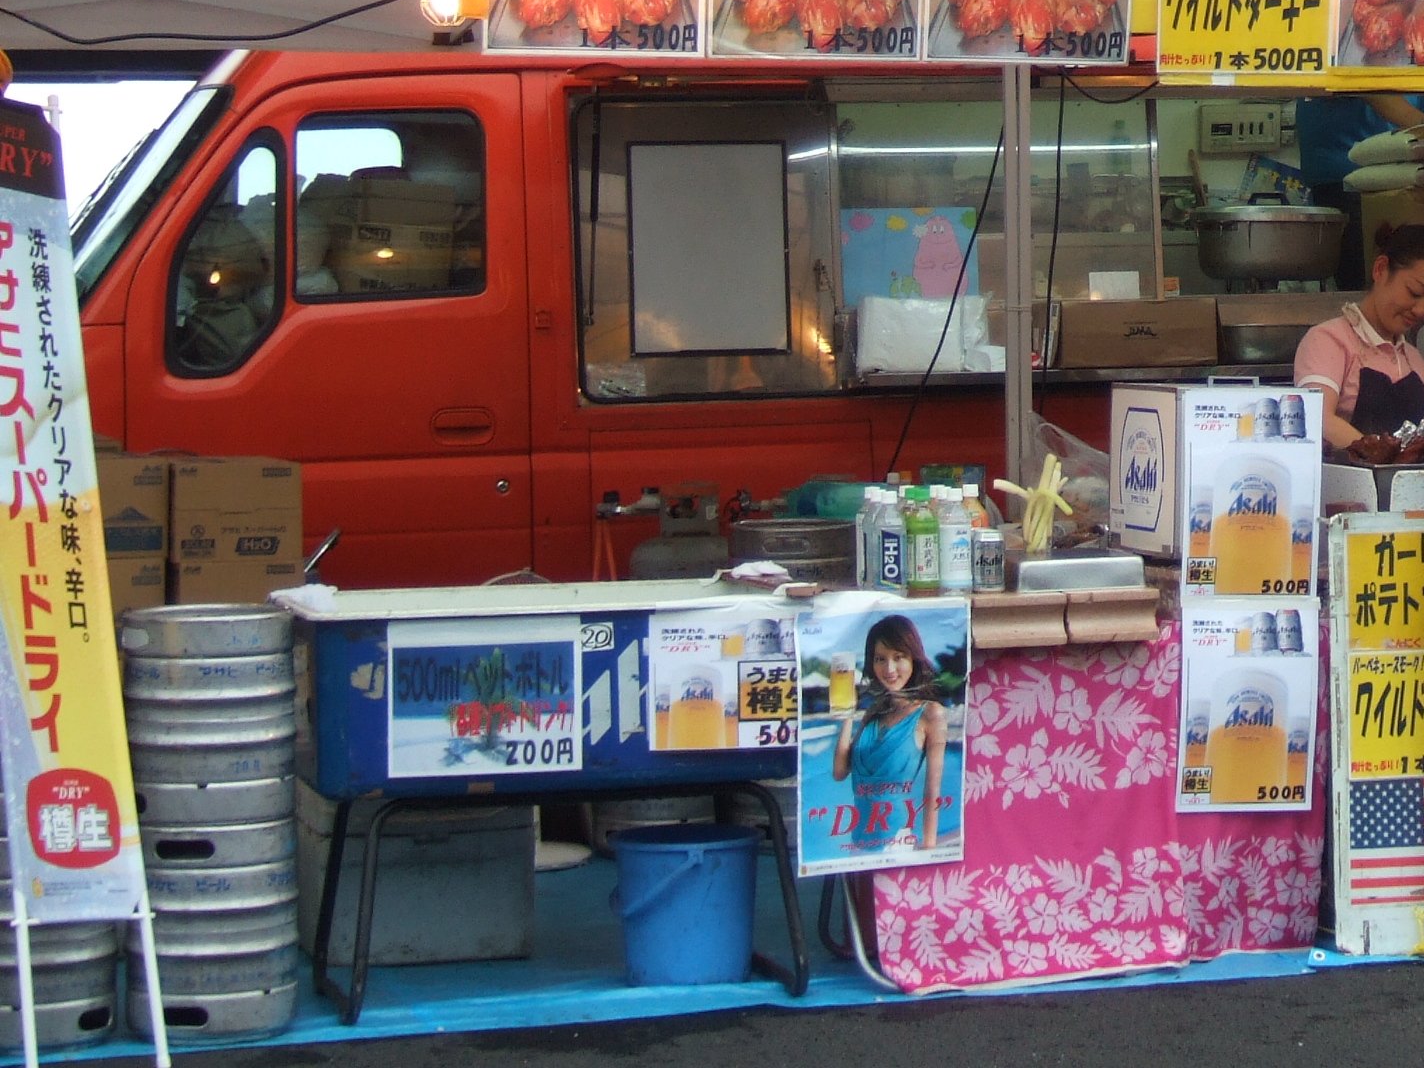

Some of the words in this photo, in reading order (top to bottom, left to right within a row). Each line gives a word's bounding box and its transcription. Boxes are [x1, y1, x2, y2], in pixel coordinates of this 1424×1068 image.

[1213, 47, 1323, 71] 1本500円
[1125, 456, 1157, 492] Asahi
[1228, 493, 1278, 517] Asahi
[1261, 579, 1310, 594] 500円
[681, 687, 714, 702] Asahi
[1225, 704, 1274, 729] Asahi
[759, 721, 798, 746] 50
[506, 737, 574, 765] 200円
[1256, 785, 1306, 800] 500円
[39, 804, 113, 853] 樽生
[808, 795, 953, 837] "DRY"
